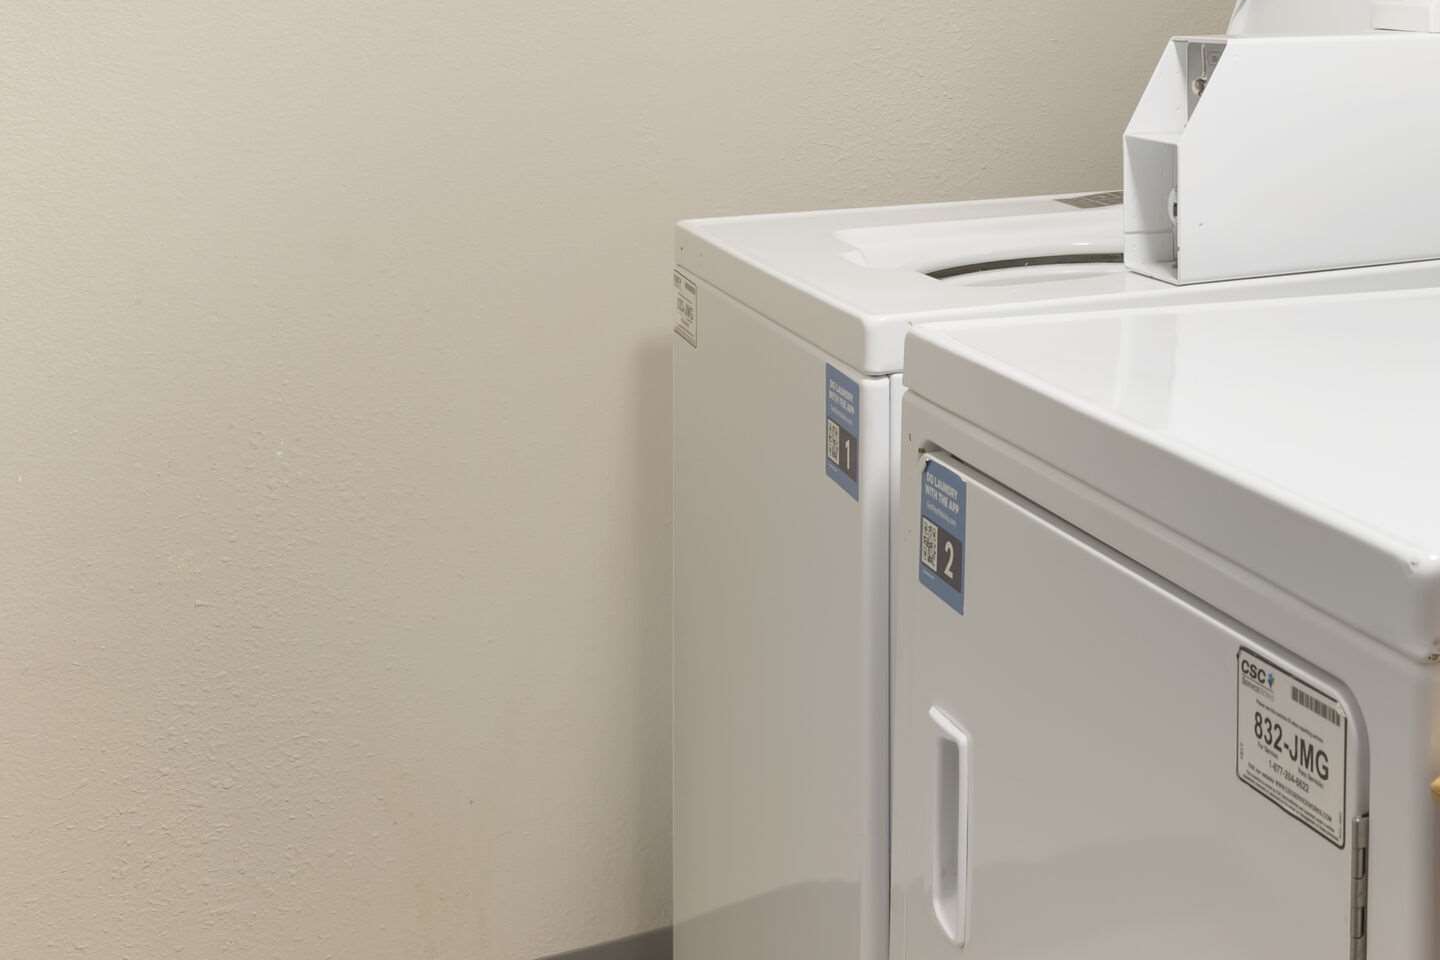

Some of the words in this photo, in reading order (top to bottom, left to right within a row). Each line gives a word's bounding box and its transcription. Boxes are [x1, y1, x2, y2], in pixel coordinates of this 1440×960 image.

[844, 440, 851, 469] 1
[943, 541, 954, 578] 2
[1241, 659, 1266, 684] CSC
[1254, 711, 1329, 781] 832-JMG
